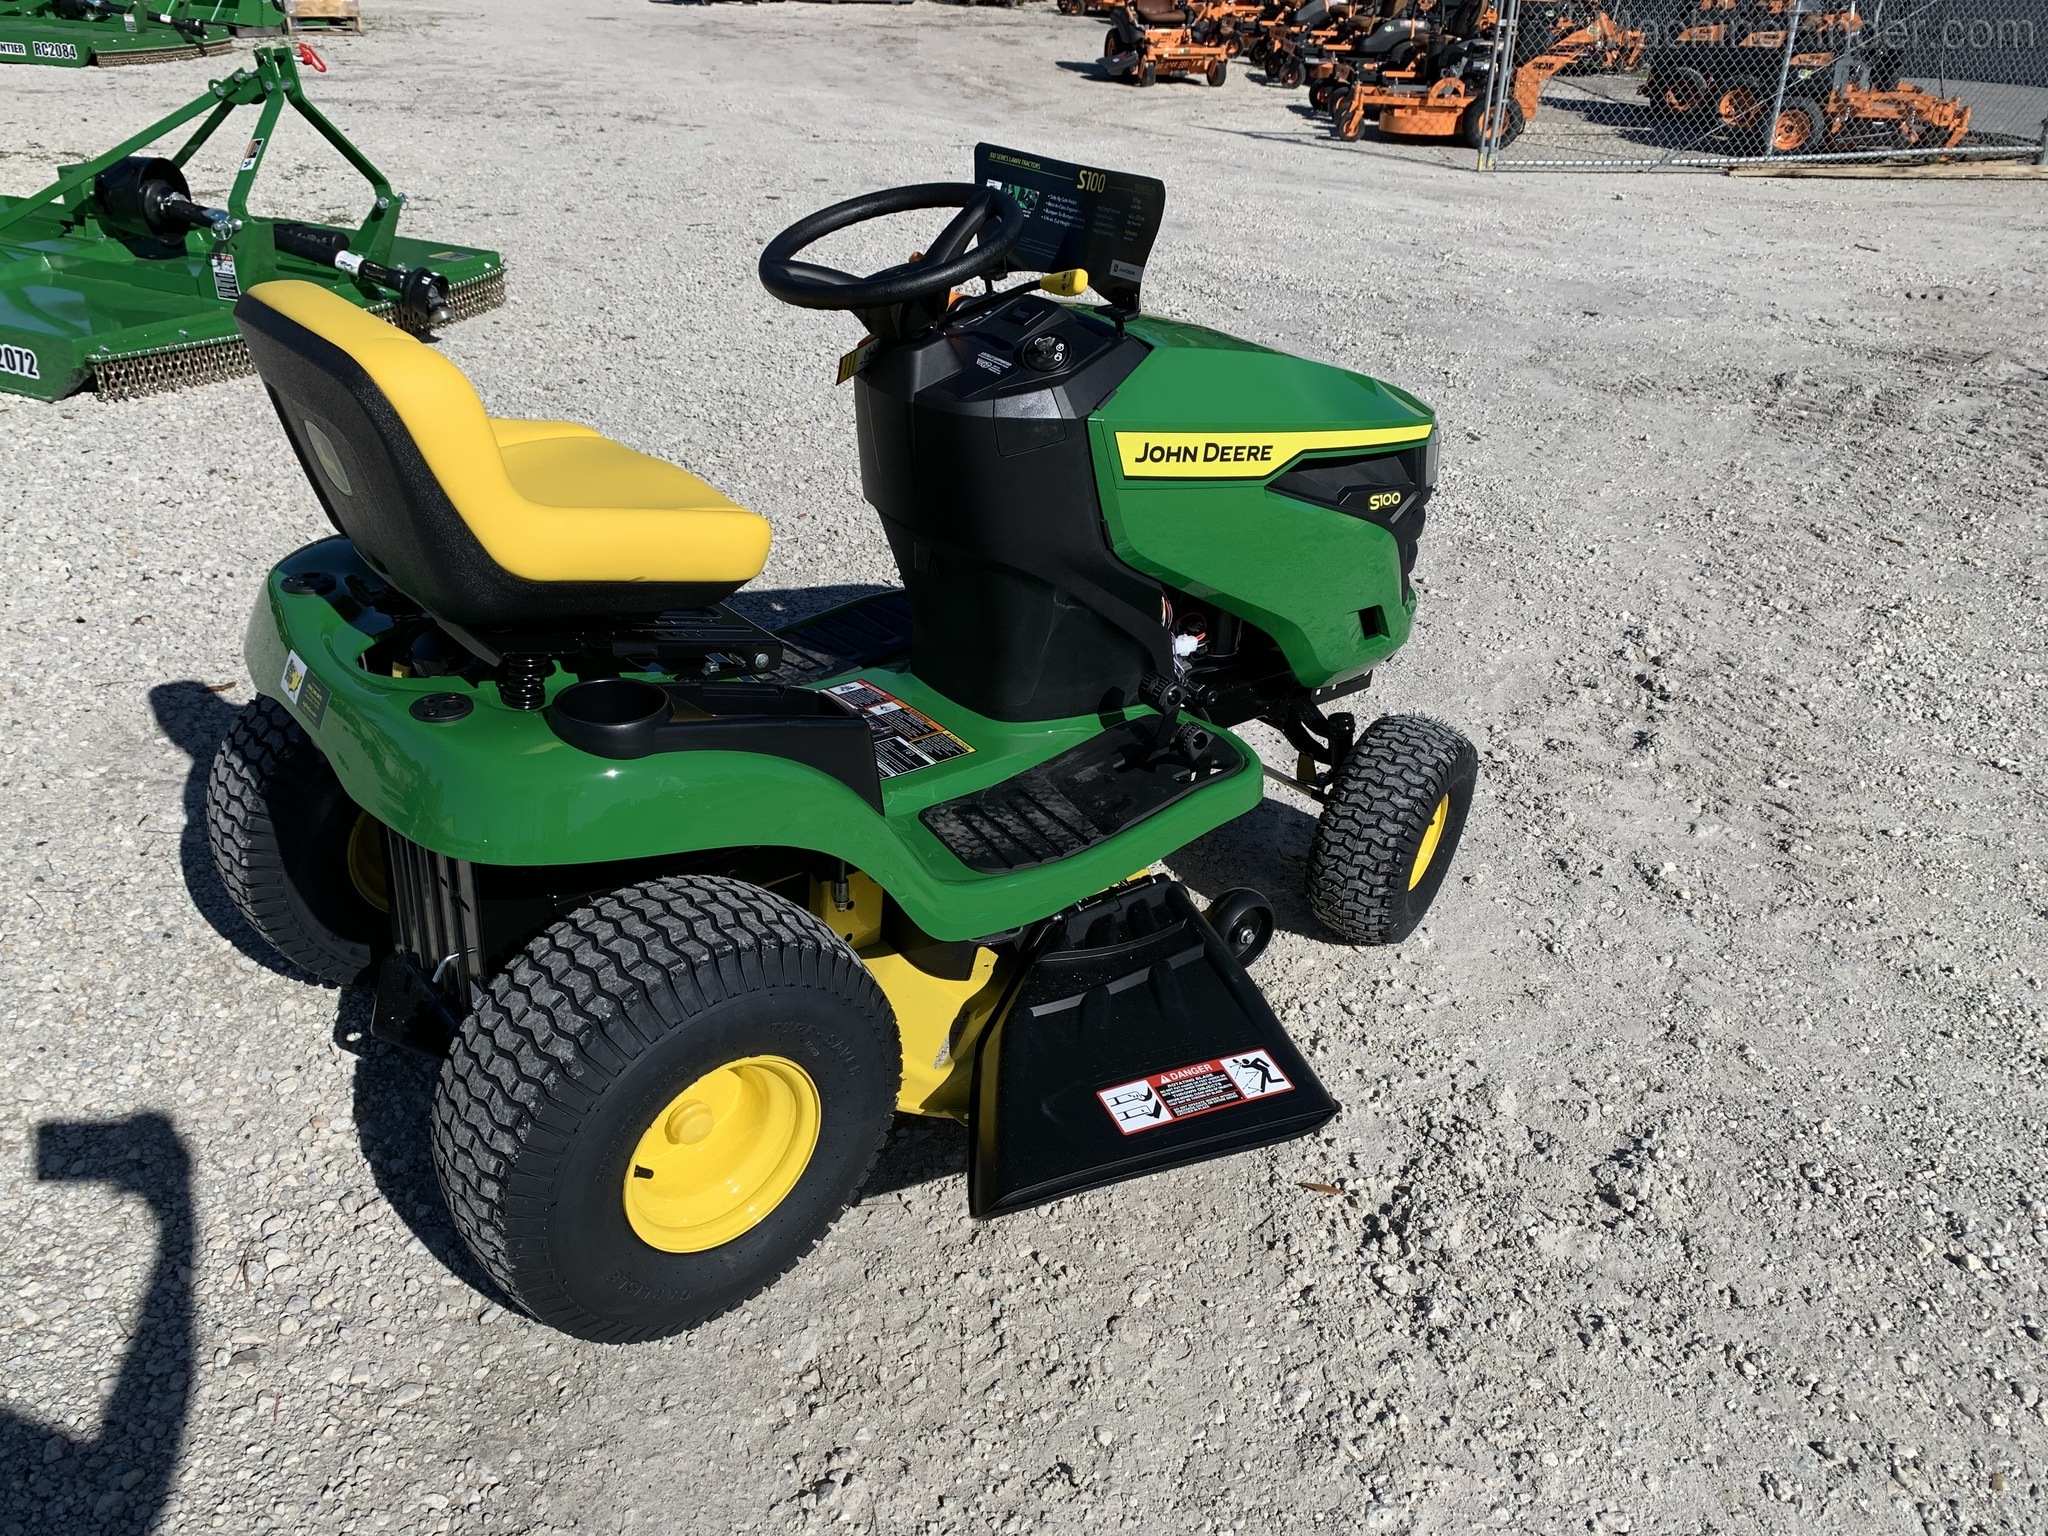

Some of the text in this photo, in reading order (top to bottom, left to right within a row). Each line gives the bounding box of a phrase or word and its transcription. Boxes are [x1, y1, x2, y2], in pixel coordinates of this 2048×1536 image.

[34, 42, 77, 58] RC2084
[1021, 158, 1041, 169] TRACTORS
[1077, 170, 1106, 193] S100
[1135, 442, 1273, 462] JOHN DEERE
[1370, 492, 1400, 510] S100
[950, 735, 970, 749] CAUTION
[1169, 1063, 1213, 1080] DANGER
